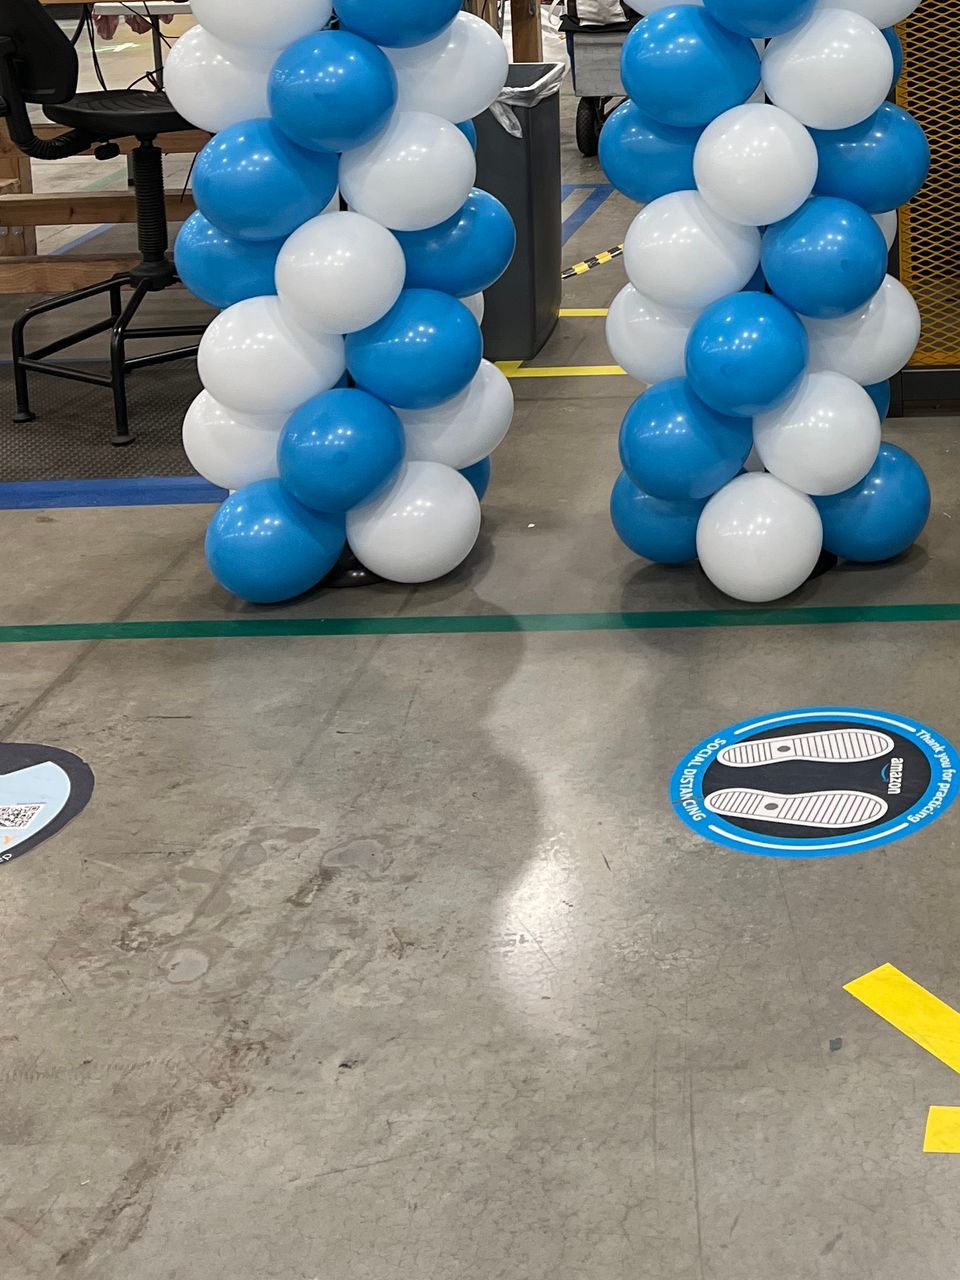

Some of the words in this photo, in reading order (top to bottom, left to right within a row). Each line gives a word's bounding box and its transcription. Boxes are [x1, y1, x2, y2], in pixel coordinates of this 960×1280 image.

[687, 738, 727, 767] SOCIAL
[916, 729, 946, 753] Thank
[934, 752, 952, 768] you
[887, 757, 904, 794] amazon
[942, 769, 957, 782] for
[679, 768, 707, 822] DISTANCING
[907, 782, 951, 823] practicing
